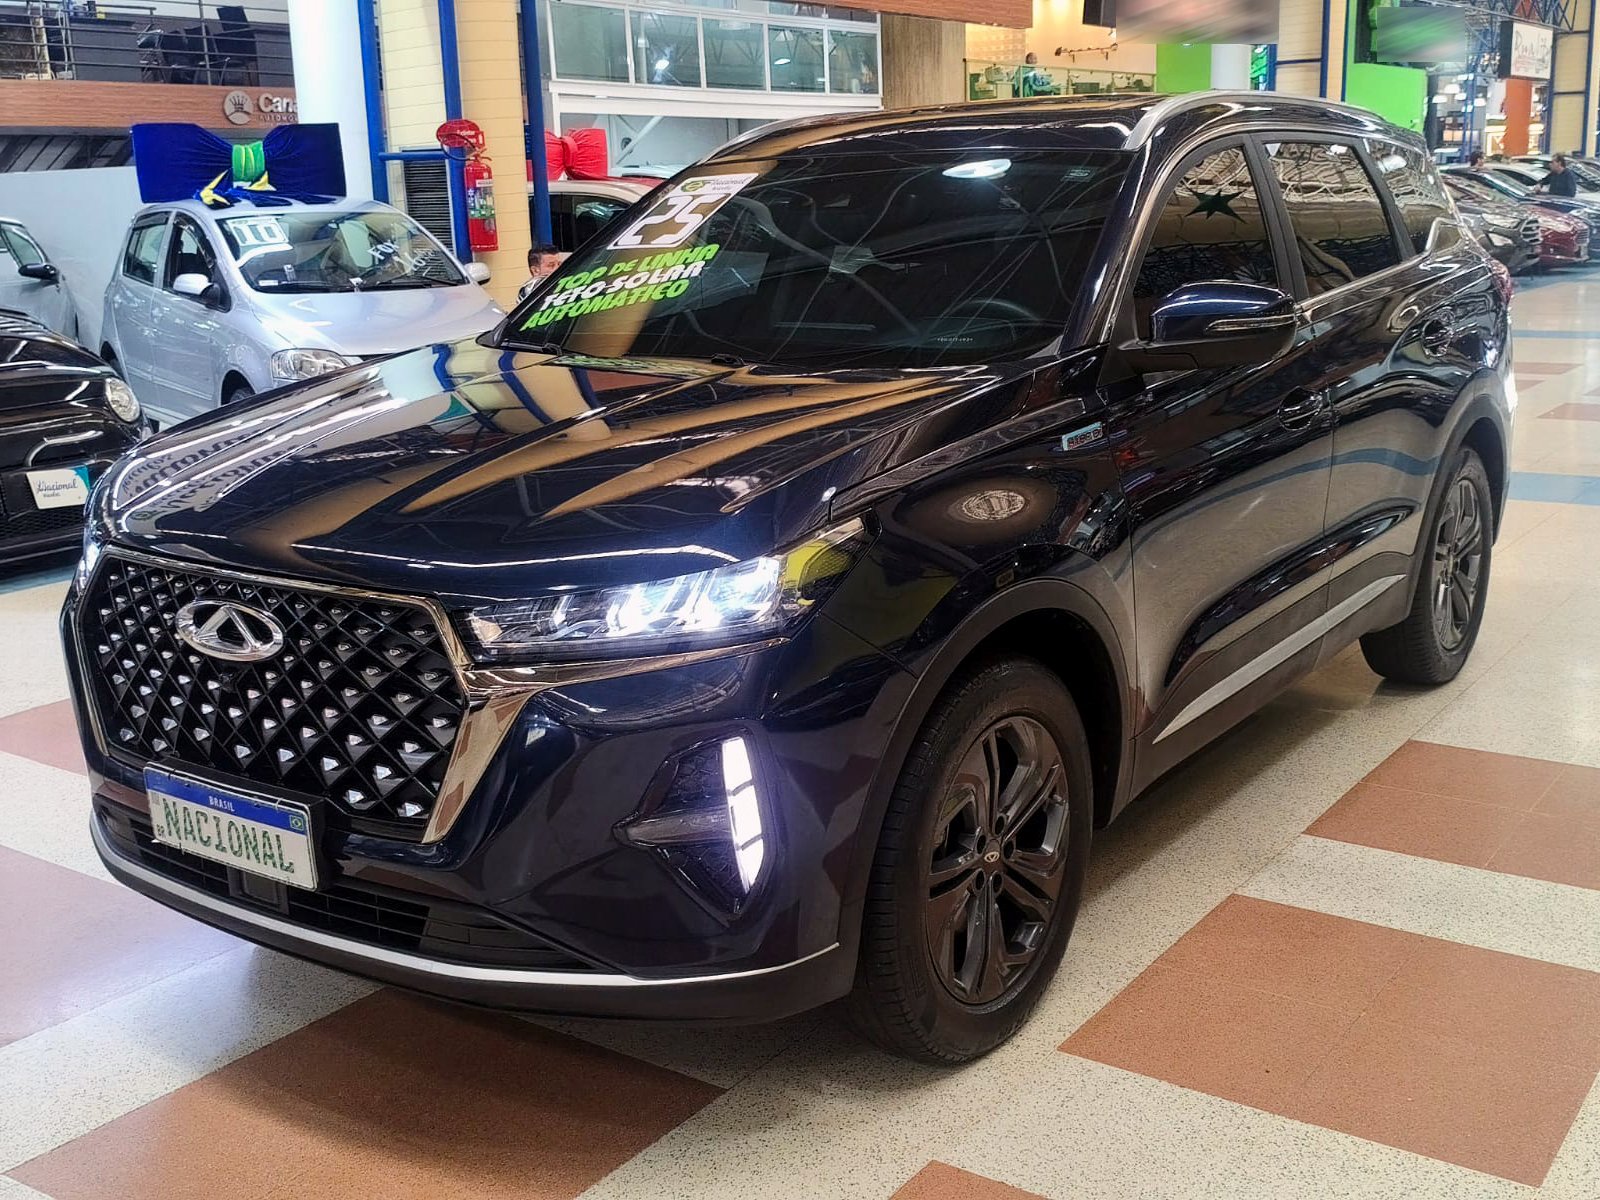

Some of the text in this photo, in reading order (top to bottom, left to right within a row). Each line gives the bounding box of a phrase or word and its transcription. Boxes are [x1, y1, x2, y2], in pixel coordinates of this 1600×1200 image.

[616, 194, 728, 245] 25
[555, 244, 720, 293] TOP DE LINHA
[519, 279, 690, 332] AUTOMATICO
[209, 796, 235, 812] BRASIL
[163, 799, 295, 874] NACIONAL
